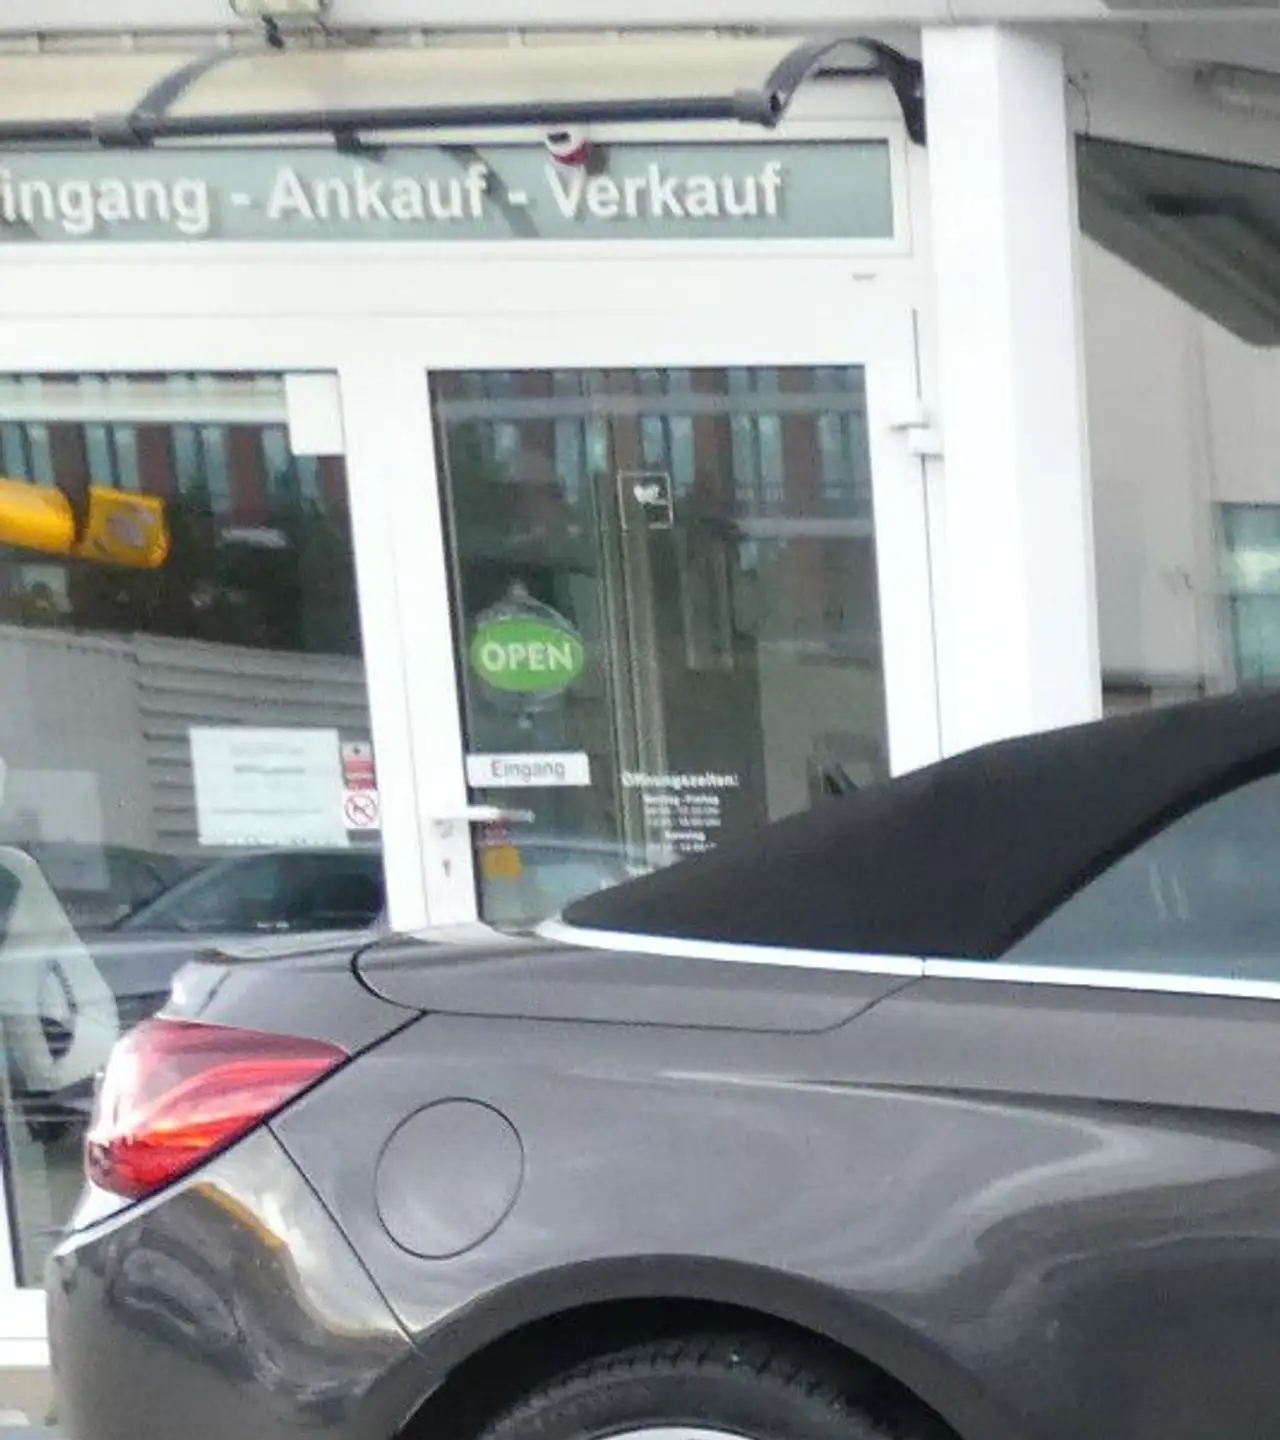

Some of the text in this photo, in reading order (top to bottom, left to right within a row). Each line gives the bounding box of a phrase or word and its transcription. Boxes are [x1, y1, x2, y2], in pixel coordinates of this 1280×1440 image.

[267, 163, 488, 221] Ankauf
[545, 161, 782, 219] Verkauf
[481, 640, 573, 671] OPEN
[491, 759, 565, 782] Eingang
